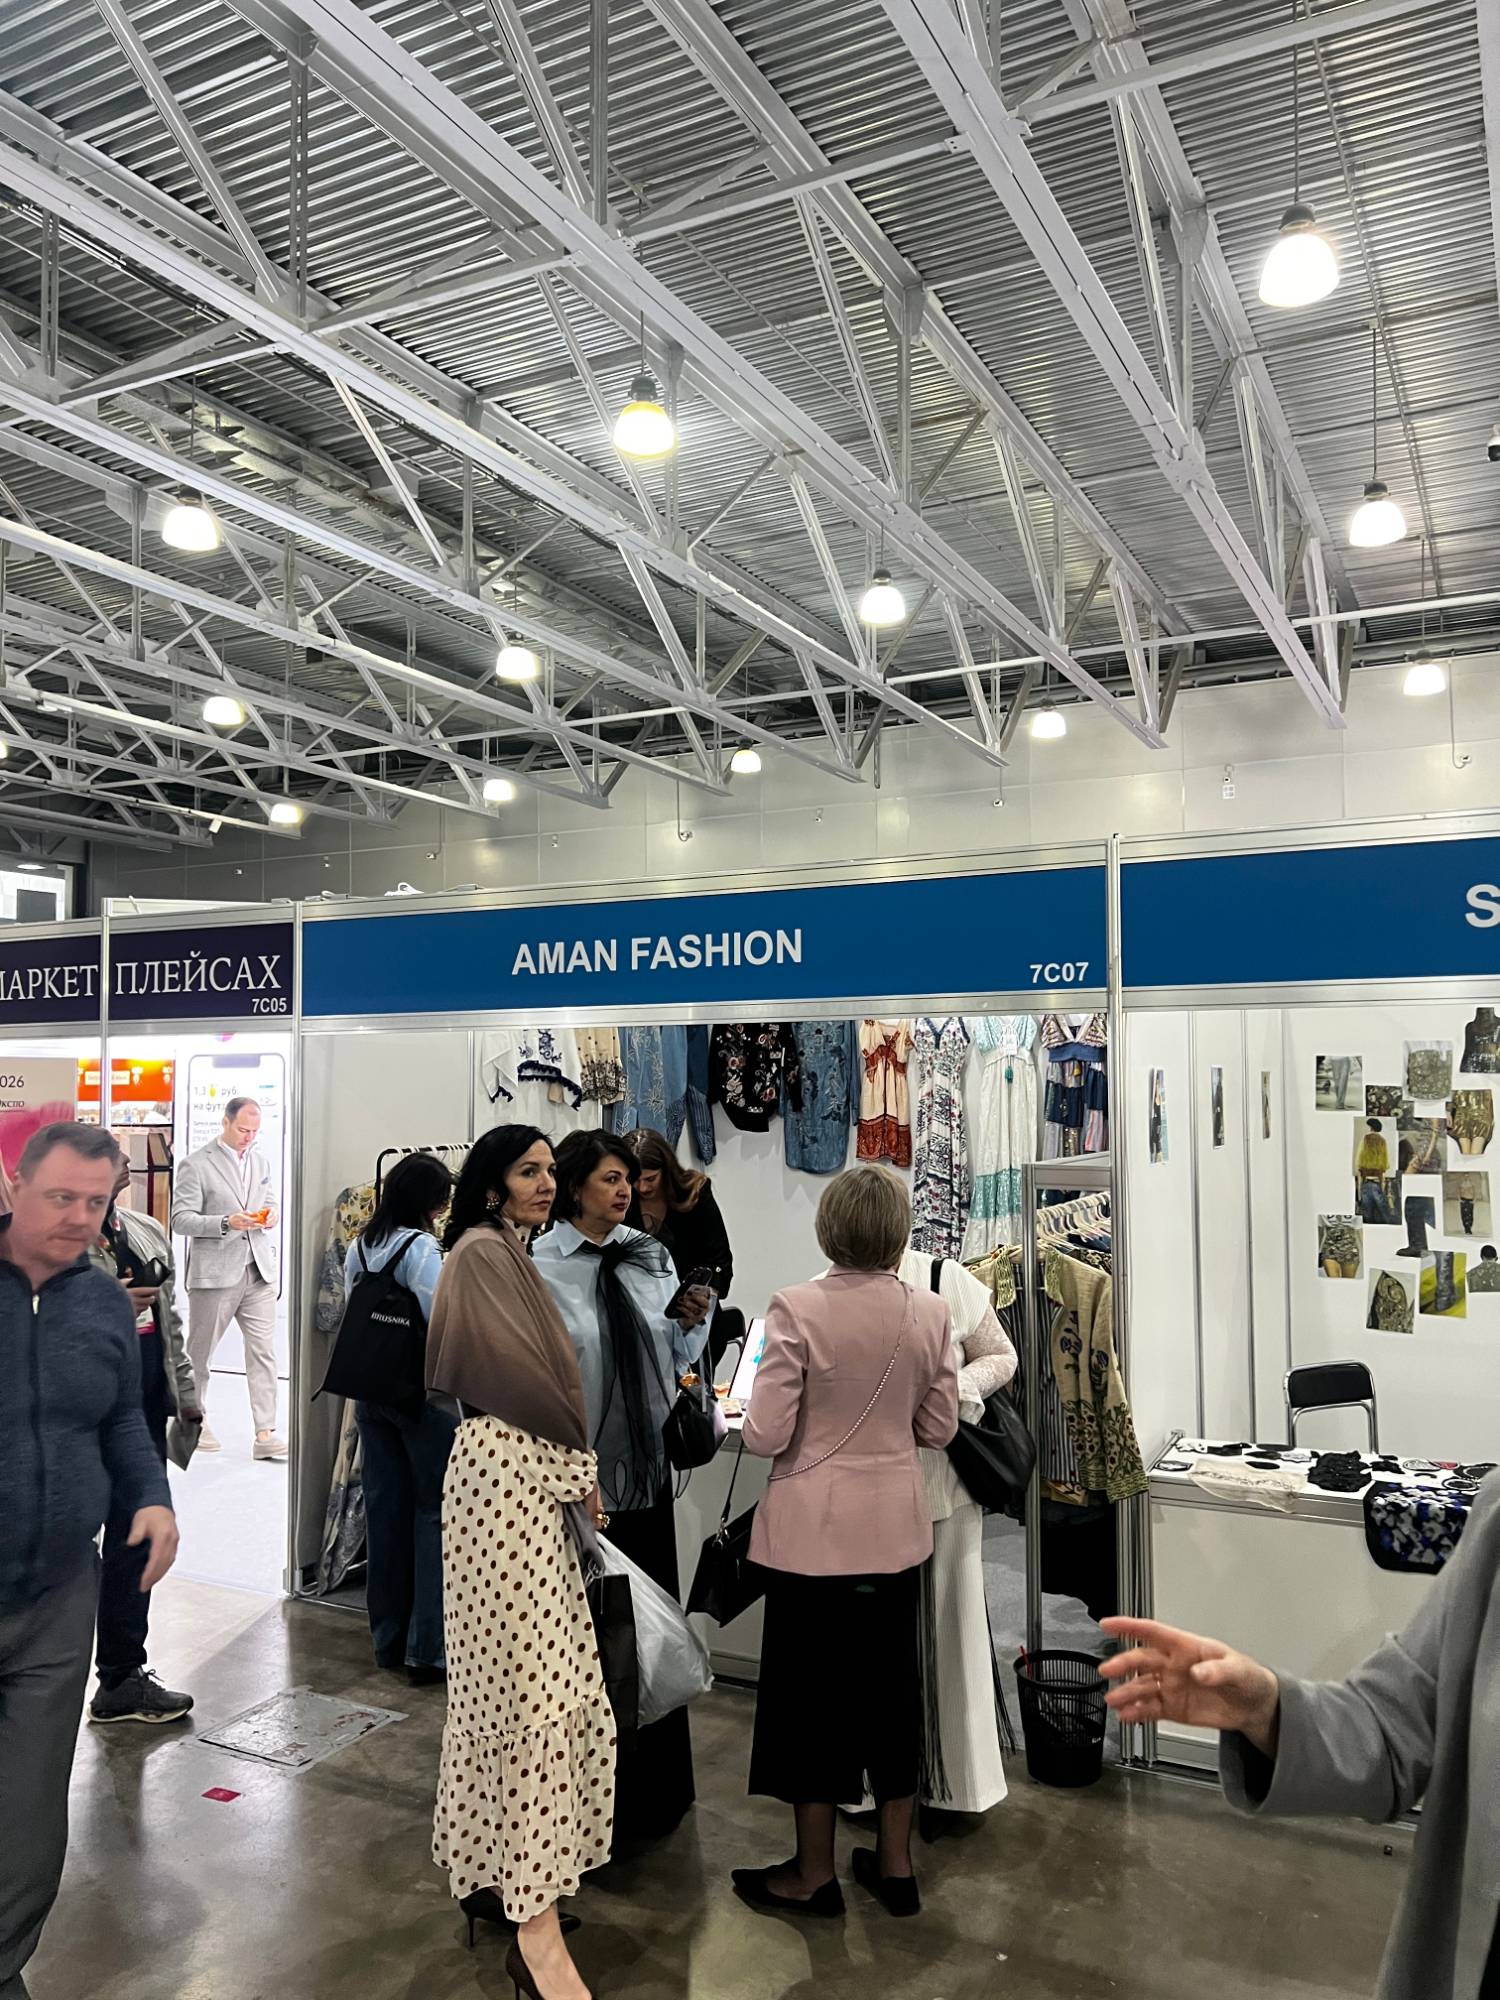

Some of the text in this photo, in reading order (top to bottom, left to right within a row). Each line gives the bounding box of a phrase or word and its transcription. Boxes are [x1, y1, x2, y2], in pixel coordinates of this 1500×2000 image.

[511, 928, 802, 975] AMAN FASHION
[0, 950, 282, 1000] АРКЕТ ПЛЕЙСАХ
[1029, 961, 1089, 983] 7C07
[251, 997, 287, 1013] 7C05
